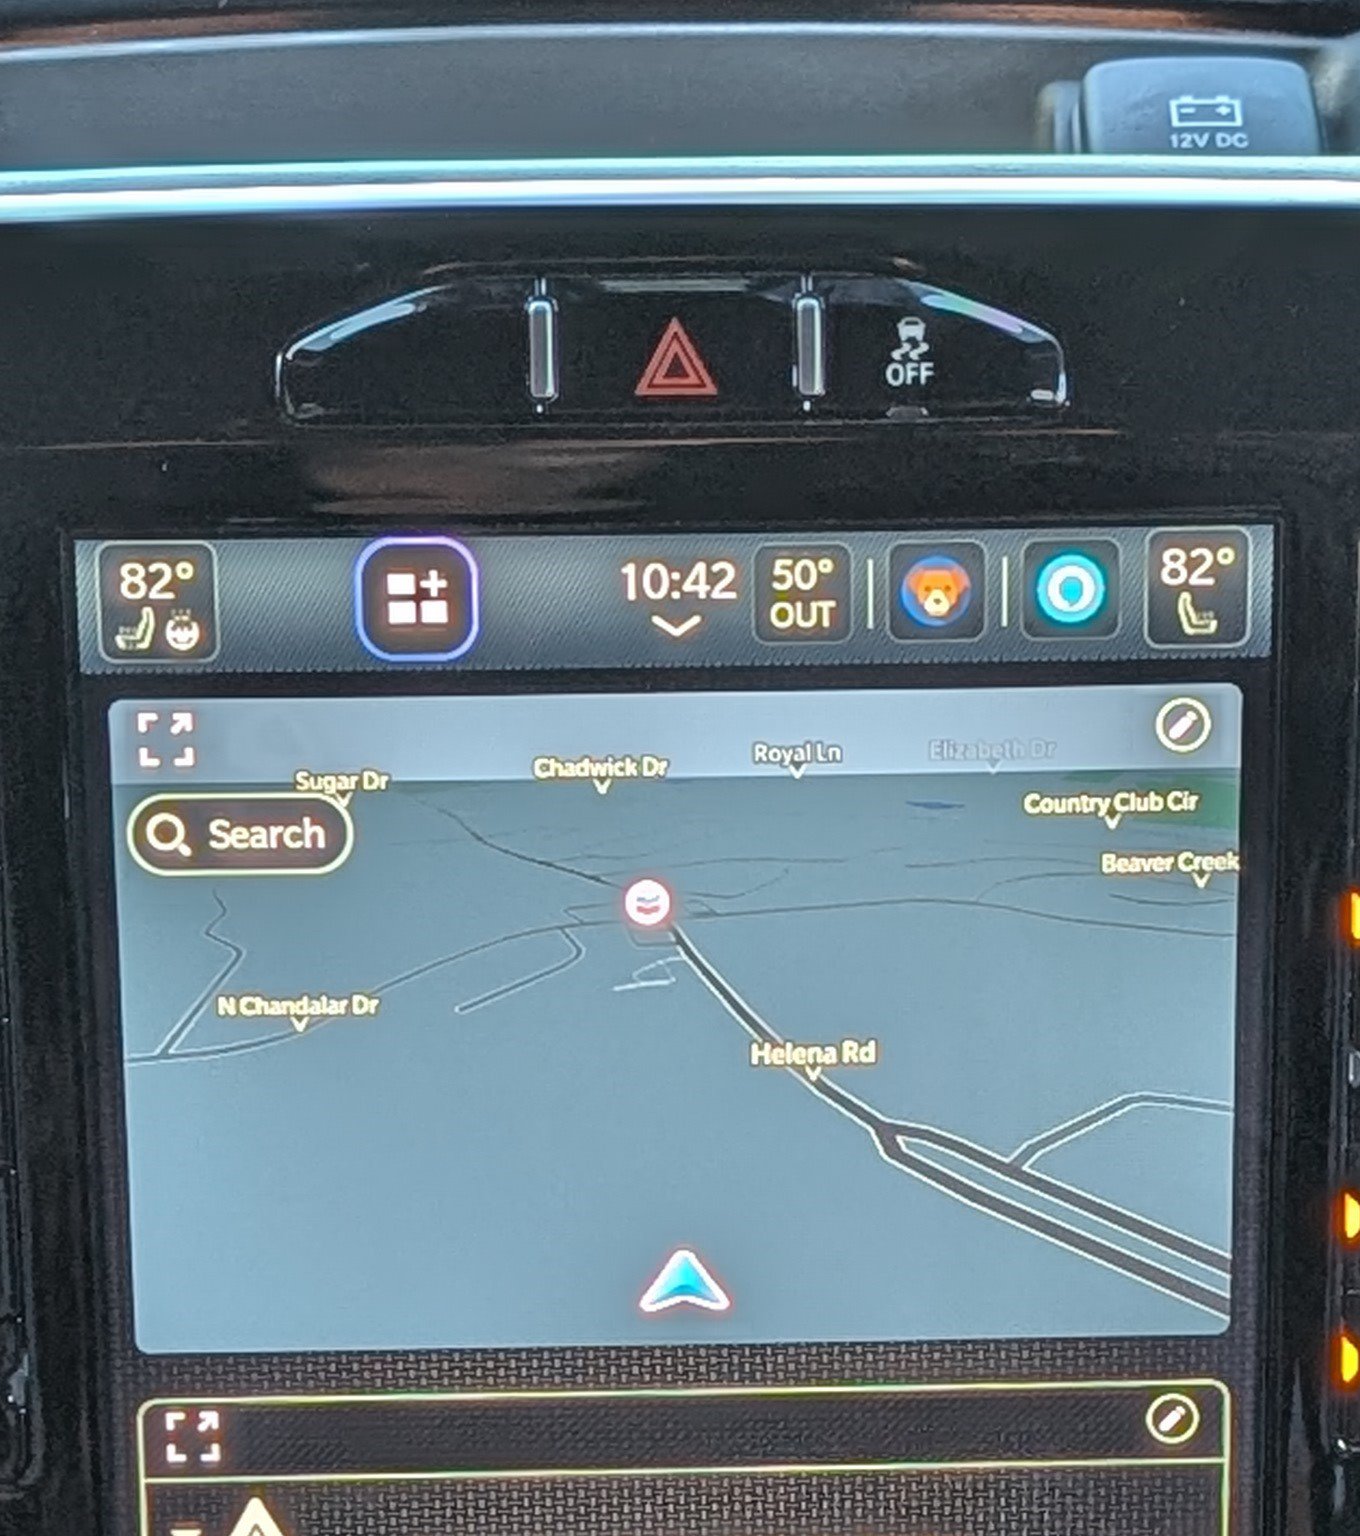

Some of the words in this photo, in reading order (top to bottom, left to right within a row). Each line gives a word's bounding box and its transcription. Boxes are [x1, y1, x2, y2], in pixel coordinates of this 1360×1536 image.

[1169, 132, 1210, 149] 12V
[1215, 132, 1249, 148] DC
[885, 361, 935, 387] OFF
[621, 561, 738, 601] 10:42
[770, 600, 836, 629] OUT
[753, 743, 811, 766] Royal
[816, 744, 842, 763] Ln
[929, 740, 1018, 761] Elizabeth
[1023, 740, 1057, 759] Dr
[534, 757, 638, 779] Chadwick
[641, 757, 668, 777] Dr
[295, 772, 357, 796] Sugar
[361, 772, 389, 791] Dr
[1023, 794, 1109, 817] Country
[1113, 793, 1163, 812] Club
[1167, 792, 1198, 812] Cir
[208, 817, 326, 851] Search
[1102, 854, 1173, 873] Beaver
[1178, 852, 1240, 873] Creek
[217, 997, 236, 1016] N
[239, 995, 347, 1017] Chandalar
[352, 995, 379, 1015] Dr
[751, 1043, 836, 1067] Helena
[841, 1041, 876, 1064] Rd
